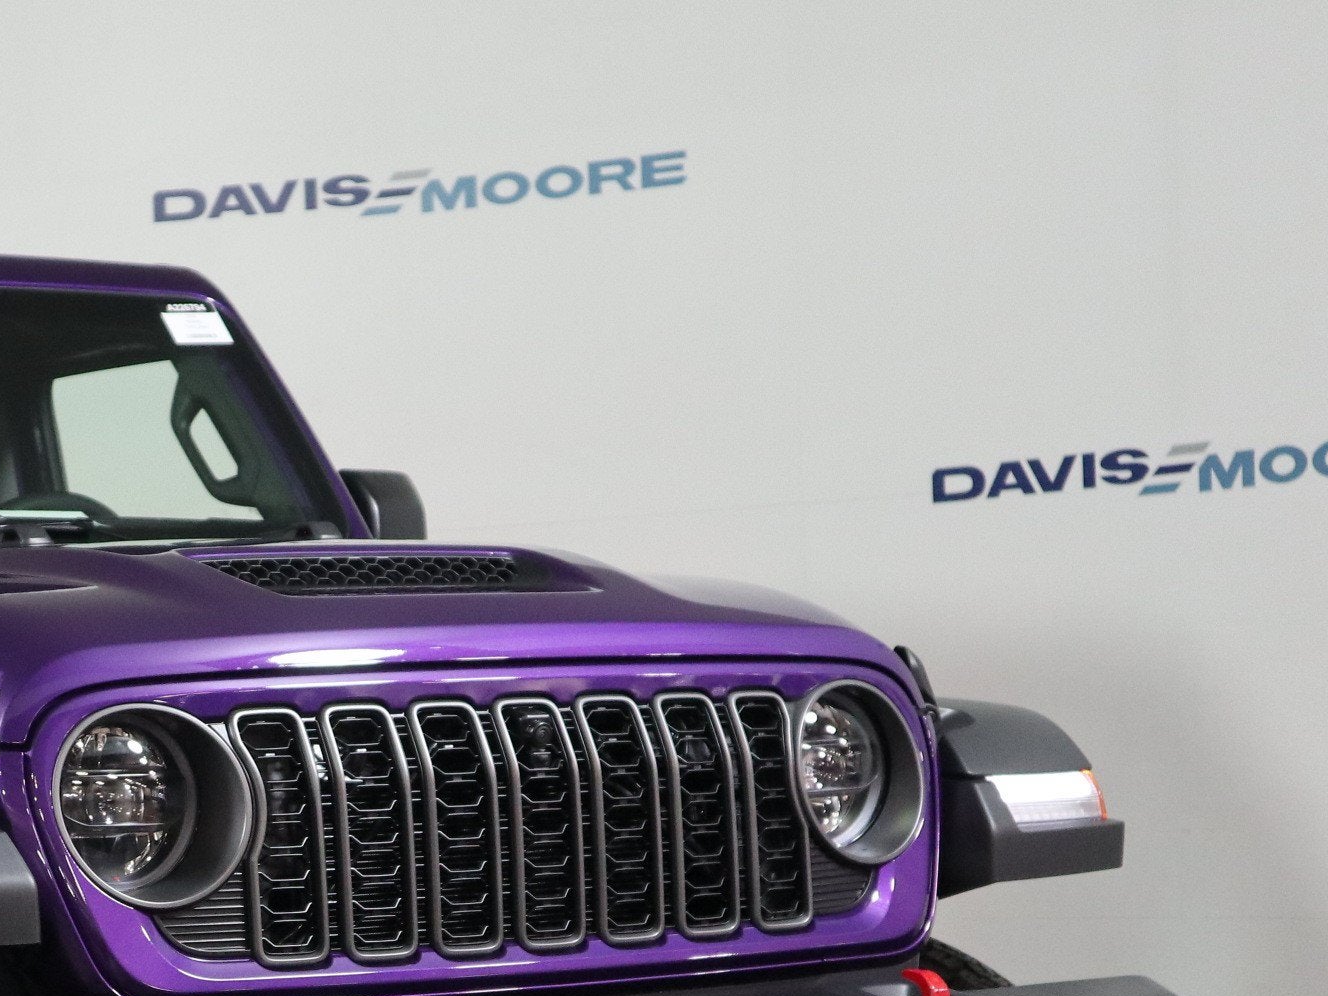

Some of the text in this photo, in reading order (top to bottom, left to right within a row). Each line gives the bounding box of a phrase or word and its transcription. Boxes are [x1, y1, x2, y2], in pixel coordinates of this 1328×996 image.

[152, 149, 688, 223] DAVIS MOORE
[930, 447, 1151, 504] DAVIS
